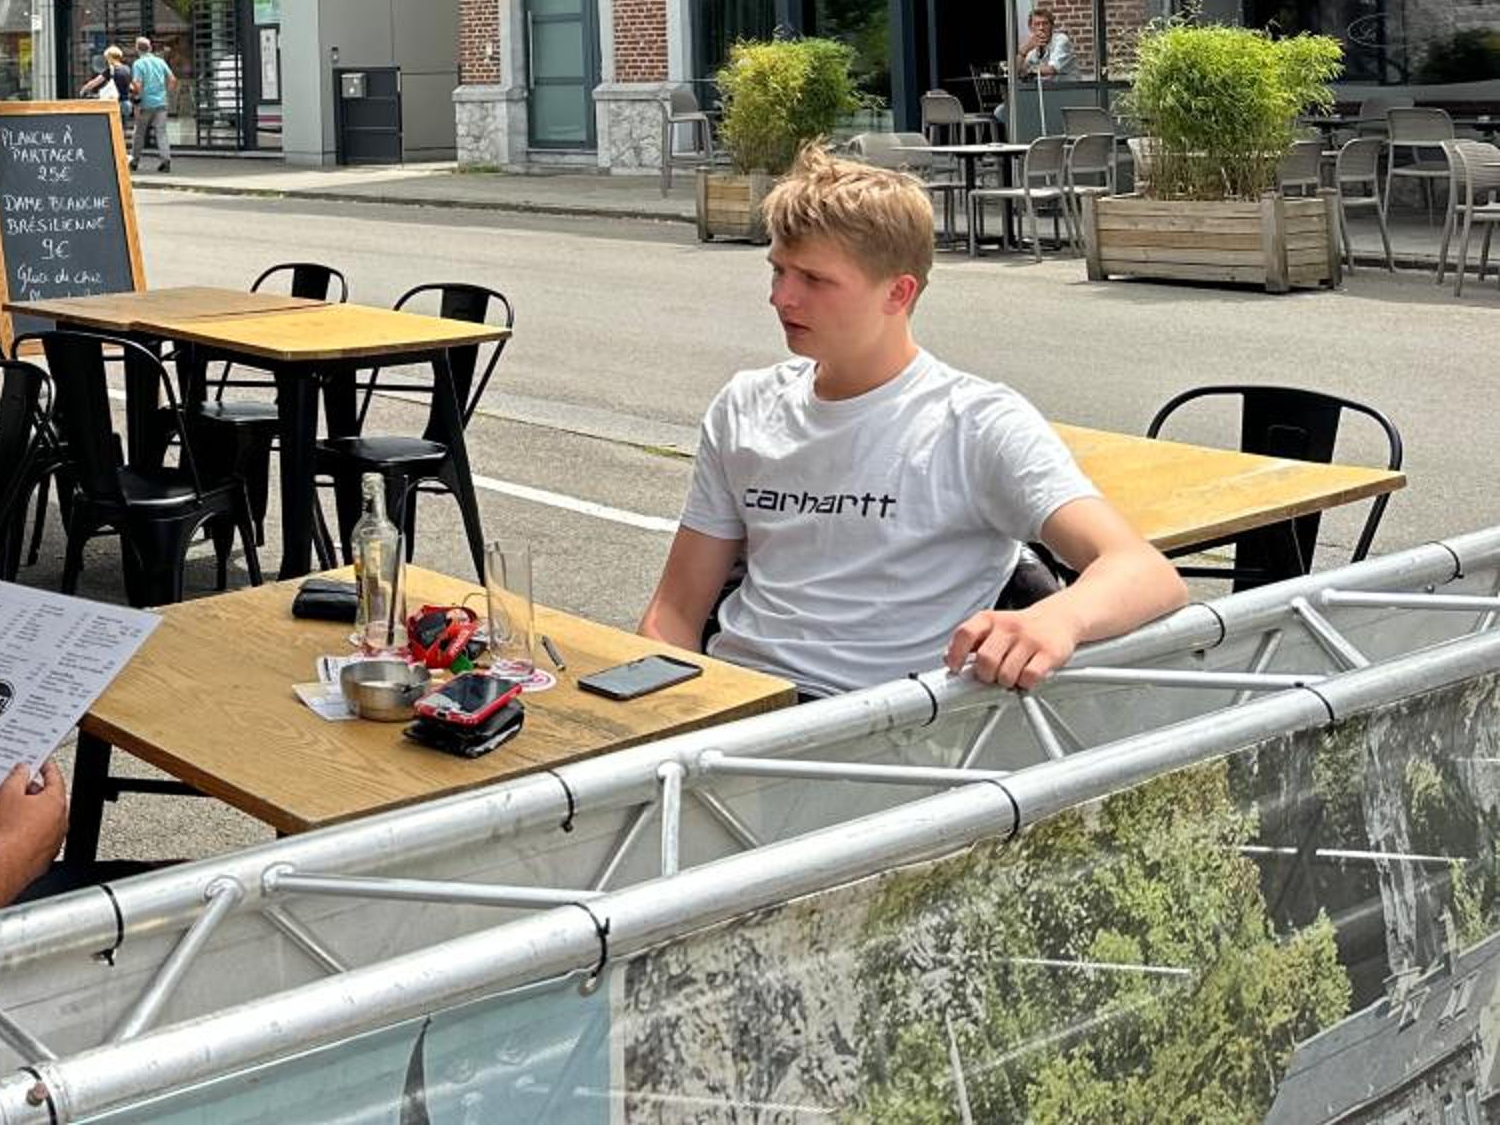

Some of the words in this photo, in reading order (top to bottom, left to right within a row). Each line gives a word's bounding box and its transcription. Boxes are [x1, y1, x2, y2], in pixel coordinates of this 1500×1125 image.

[2, 128, 55, 146] PLANCHE
[10, 147, 86, 163] PARTAGER
[37, 165, 71, 182] 25€
[3, 194, 44, 212] DAME
[48, 195, 112, 212] BLANCHE
[743, 487, 897, 518] carhartt
